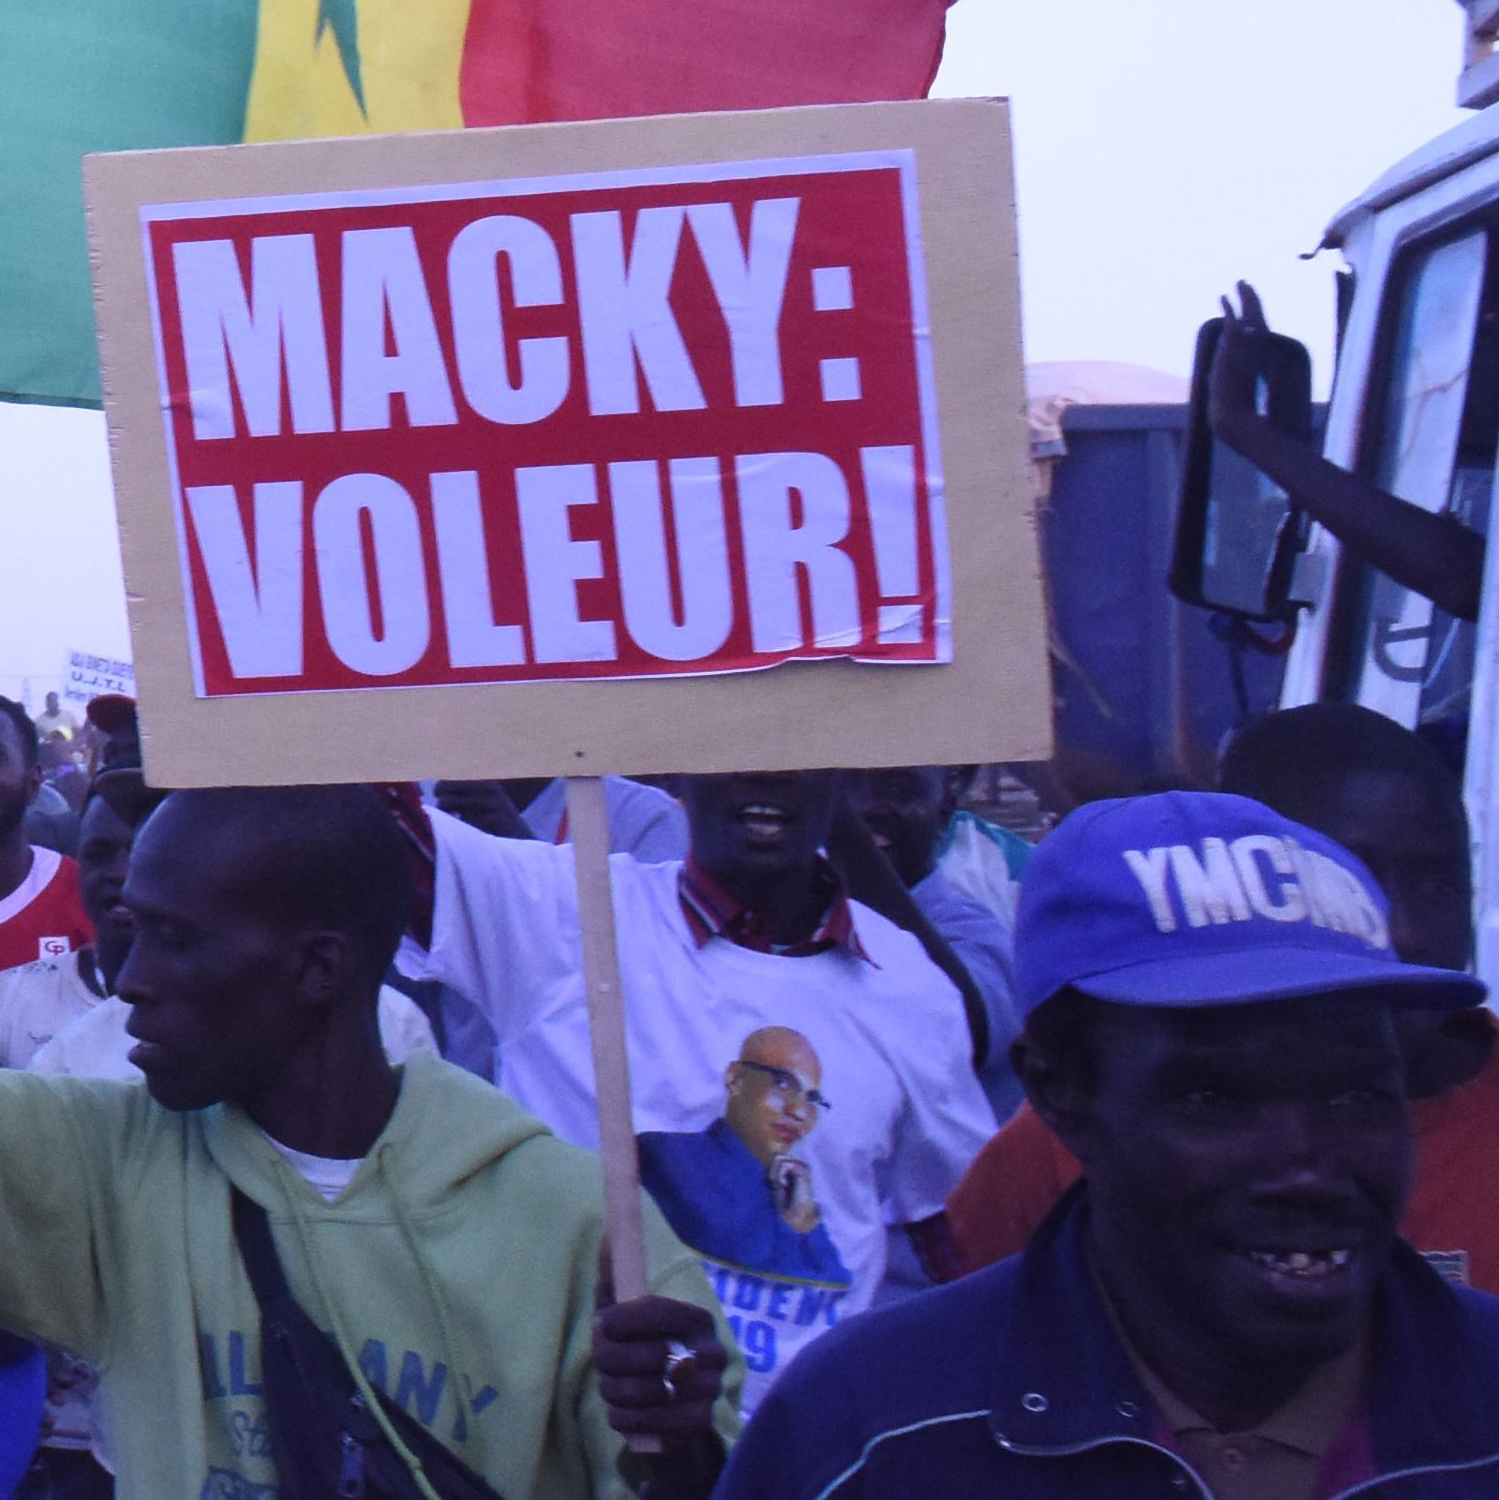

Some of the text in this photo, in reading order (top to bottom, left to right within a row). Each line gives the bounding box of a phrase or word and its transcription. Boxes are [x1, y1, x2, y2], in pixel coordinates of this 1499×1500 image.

[172, 196, 863, 440] MACKY:
[185, 444, 926, 678] VOLEUR!
[202, 1330, 499, 1445] LANY
